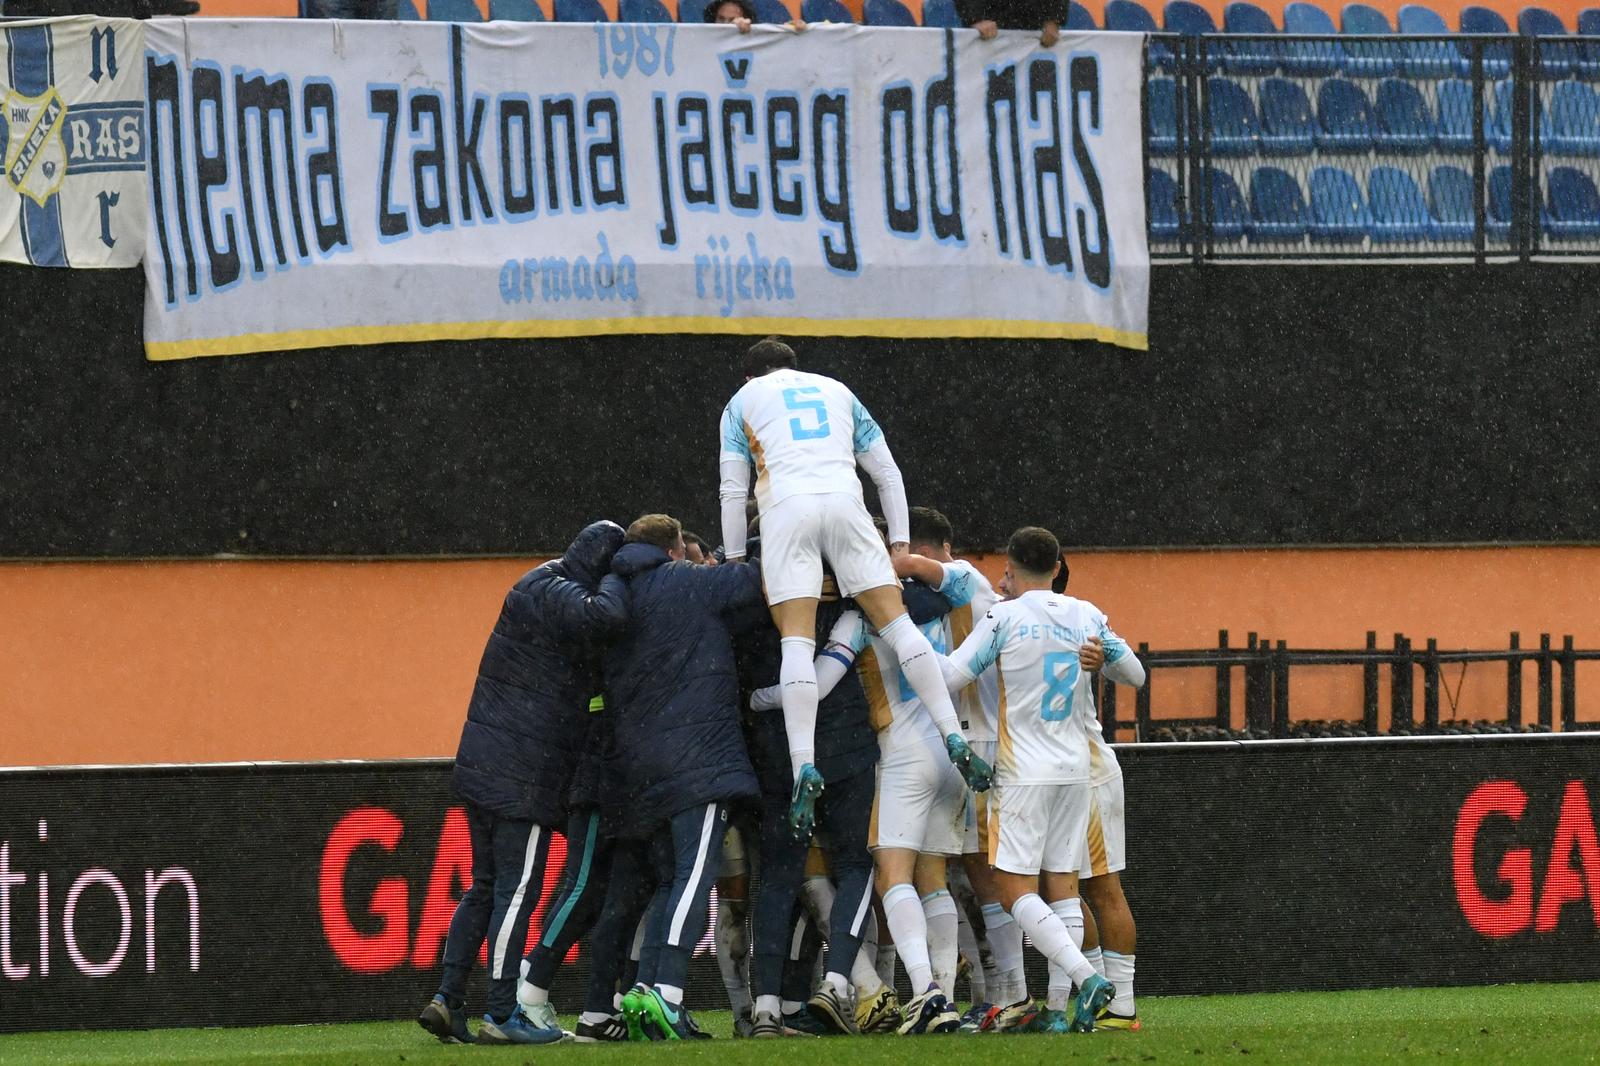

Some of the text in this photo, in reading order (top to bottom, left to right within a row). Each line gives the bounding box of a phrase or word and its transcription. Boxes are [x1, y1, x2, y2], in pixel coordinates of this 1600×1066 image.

[592, 22, 677, 79] 1987
[11, 107, 31, 123] HNK
[12, 103, 61, 182] RIJEKA
[69, 114, 141, 161] RAS
[145, 23, 1111, 311] nema zakona jačeg od nas
[499, 229, 796, 318] armada rijeka
[782, 386, 831, 441] 5
[1041, 650, 1079, 722] 8
